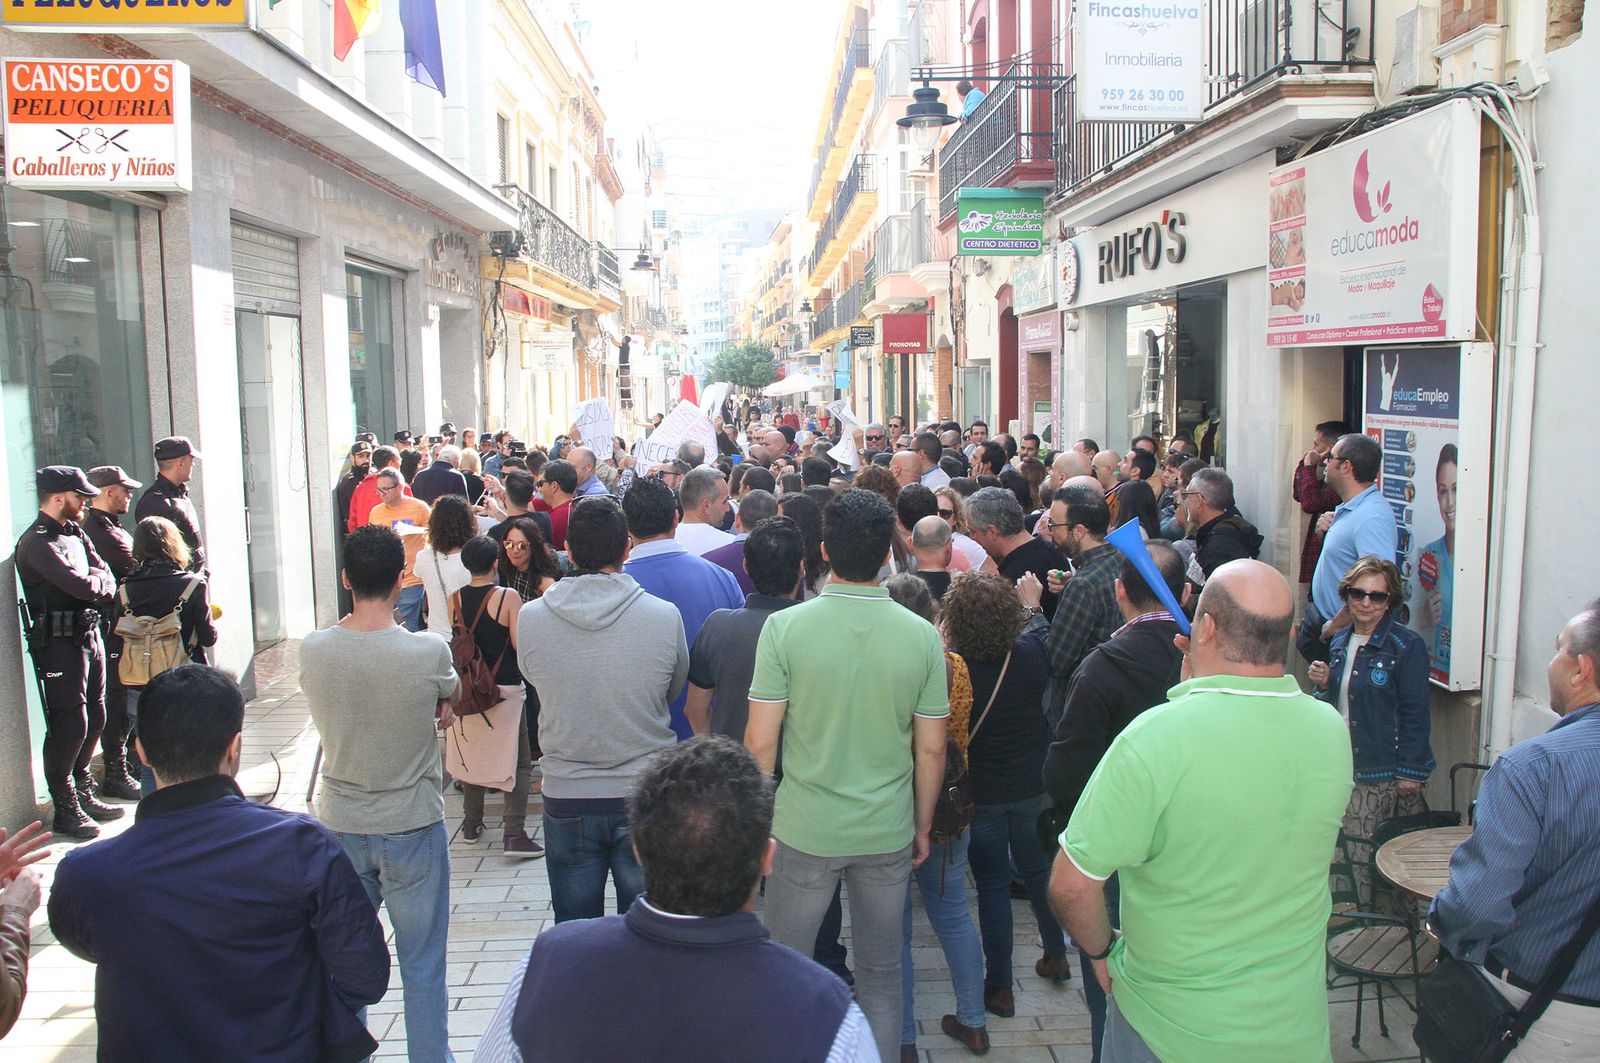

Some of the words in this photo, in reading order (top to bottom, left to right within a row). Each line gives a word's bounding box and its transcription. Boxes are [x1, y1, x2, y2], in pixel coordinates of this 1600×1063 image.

[1088, 2, 1198, 19] Fincashuelva
[1105, 52, 1183, 67] Inmobiliaria
[1101, 89, 1124, 100] 959
[1129, 89, 1144, 101] 26
[1149, 89, 1166, 101] 30
[1168, 90, 1185, 101] 00
[12, 98, 172, 120] PELUQUERIA
[12, 156, 106, 176] Caballeros
[109, 164, 121, 181] y
[126, 157, 175, 176] Niños
[965, 240, 996, 248] CENTRO
[1331, 215, 1419, 257] educamoda
[1098, 210, 1186, 284] RUFO'S
[1348, 284, 1363, 293] Moda
[1367, 279, 1396, 291] Maquillaje
[1414, 325, 1439, 335] empresas
[1393, 387, 1449, 405] educaEmpleo
[1392, 401, 1417, 411] Formación
